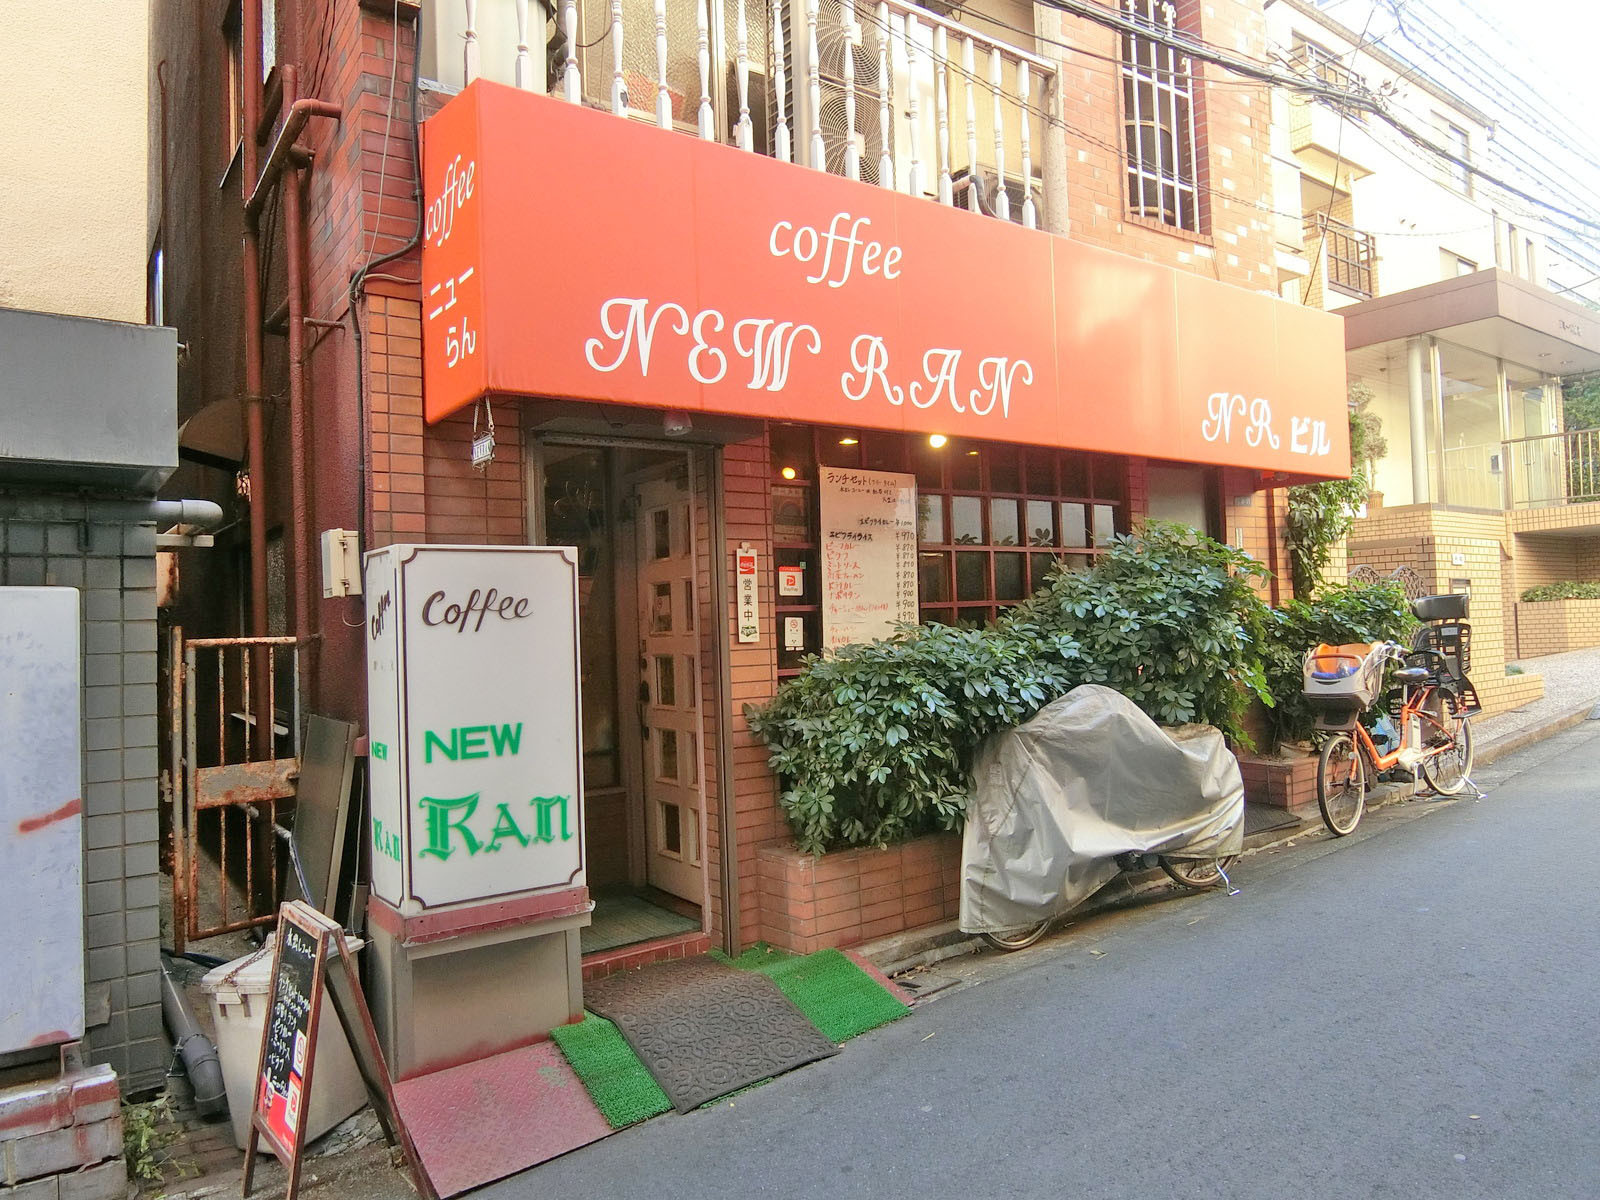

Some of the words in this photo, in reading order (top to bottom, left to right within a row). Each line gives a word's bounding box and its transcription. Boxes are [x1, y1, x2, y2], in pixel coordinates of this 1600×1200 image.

[426, 154, 475, 247] coffee
[769, 212, 903, 288] coffee
[429, 267, 474, 320] ニュー
[446, 317, 476, 368] らん
[585, 298, 821, 391] NEW
[841, 334, 1033, 418] RAN
[1202, 392, 1280, 450] NR
[1290, 416, 1330, 457] ビル
[371, 589, 391, 641] Coffee
[422, 587, 533, 633] Coffee
[743, 578, 753, 622] 営業中
[371, 741, 388, 762] NEW
[425, 722, 523, 764] NEW
